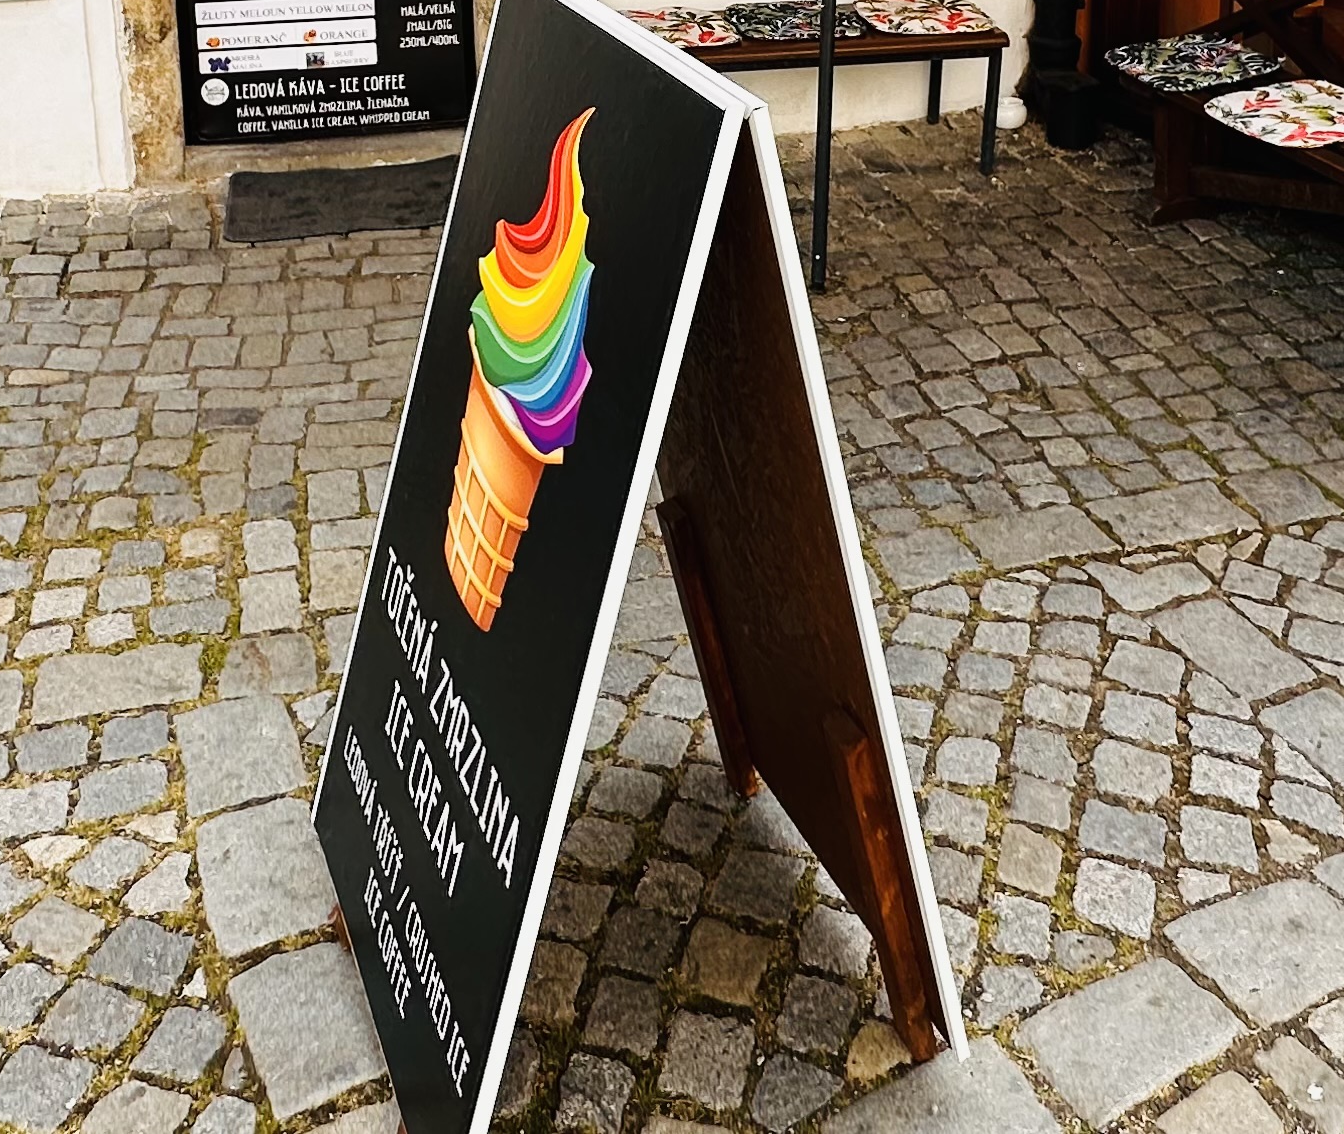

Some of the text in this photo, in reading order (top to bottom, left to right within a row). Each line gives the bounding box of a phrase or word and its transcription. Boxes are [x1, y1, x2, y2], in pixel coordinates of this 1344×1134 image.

[239, 7, 286, 18] MELOUN
[288, 4, 333, 16] YELLOW
[335, 2, 374, 14] MELON
[320, 29, 369, 41] ORANGE
[234, 78, 286, 100] LEDOVÁ
[289, 77, 326, 98] KÁVA
[340, 77, 360, 94] ICE
[363, 74, 406, 91] COFFEE
[271, 118, 310, 131] VANILLA
[311, 116, 326, 129] ICE
[359, 112, 401, 126] WHIPPED
[401, 110, 431, 122] CREAM
[381, 546, 520, 890] TOČENÁ ZMRZLINA
[384, 679, 465, 897] ICE CREAM
[343, 724, 378, 826] LEDOVÁ
[372, 803, 405, 895] TŘÍŠŤ
[405, 901, 453, 1041] CRUSHED
[446, 1020, 472, 1097] ICE
[363, 867, 413, 1020] ICE COFFEE
